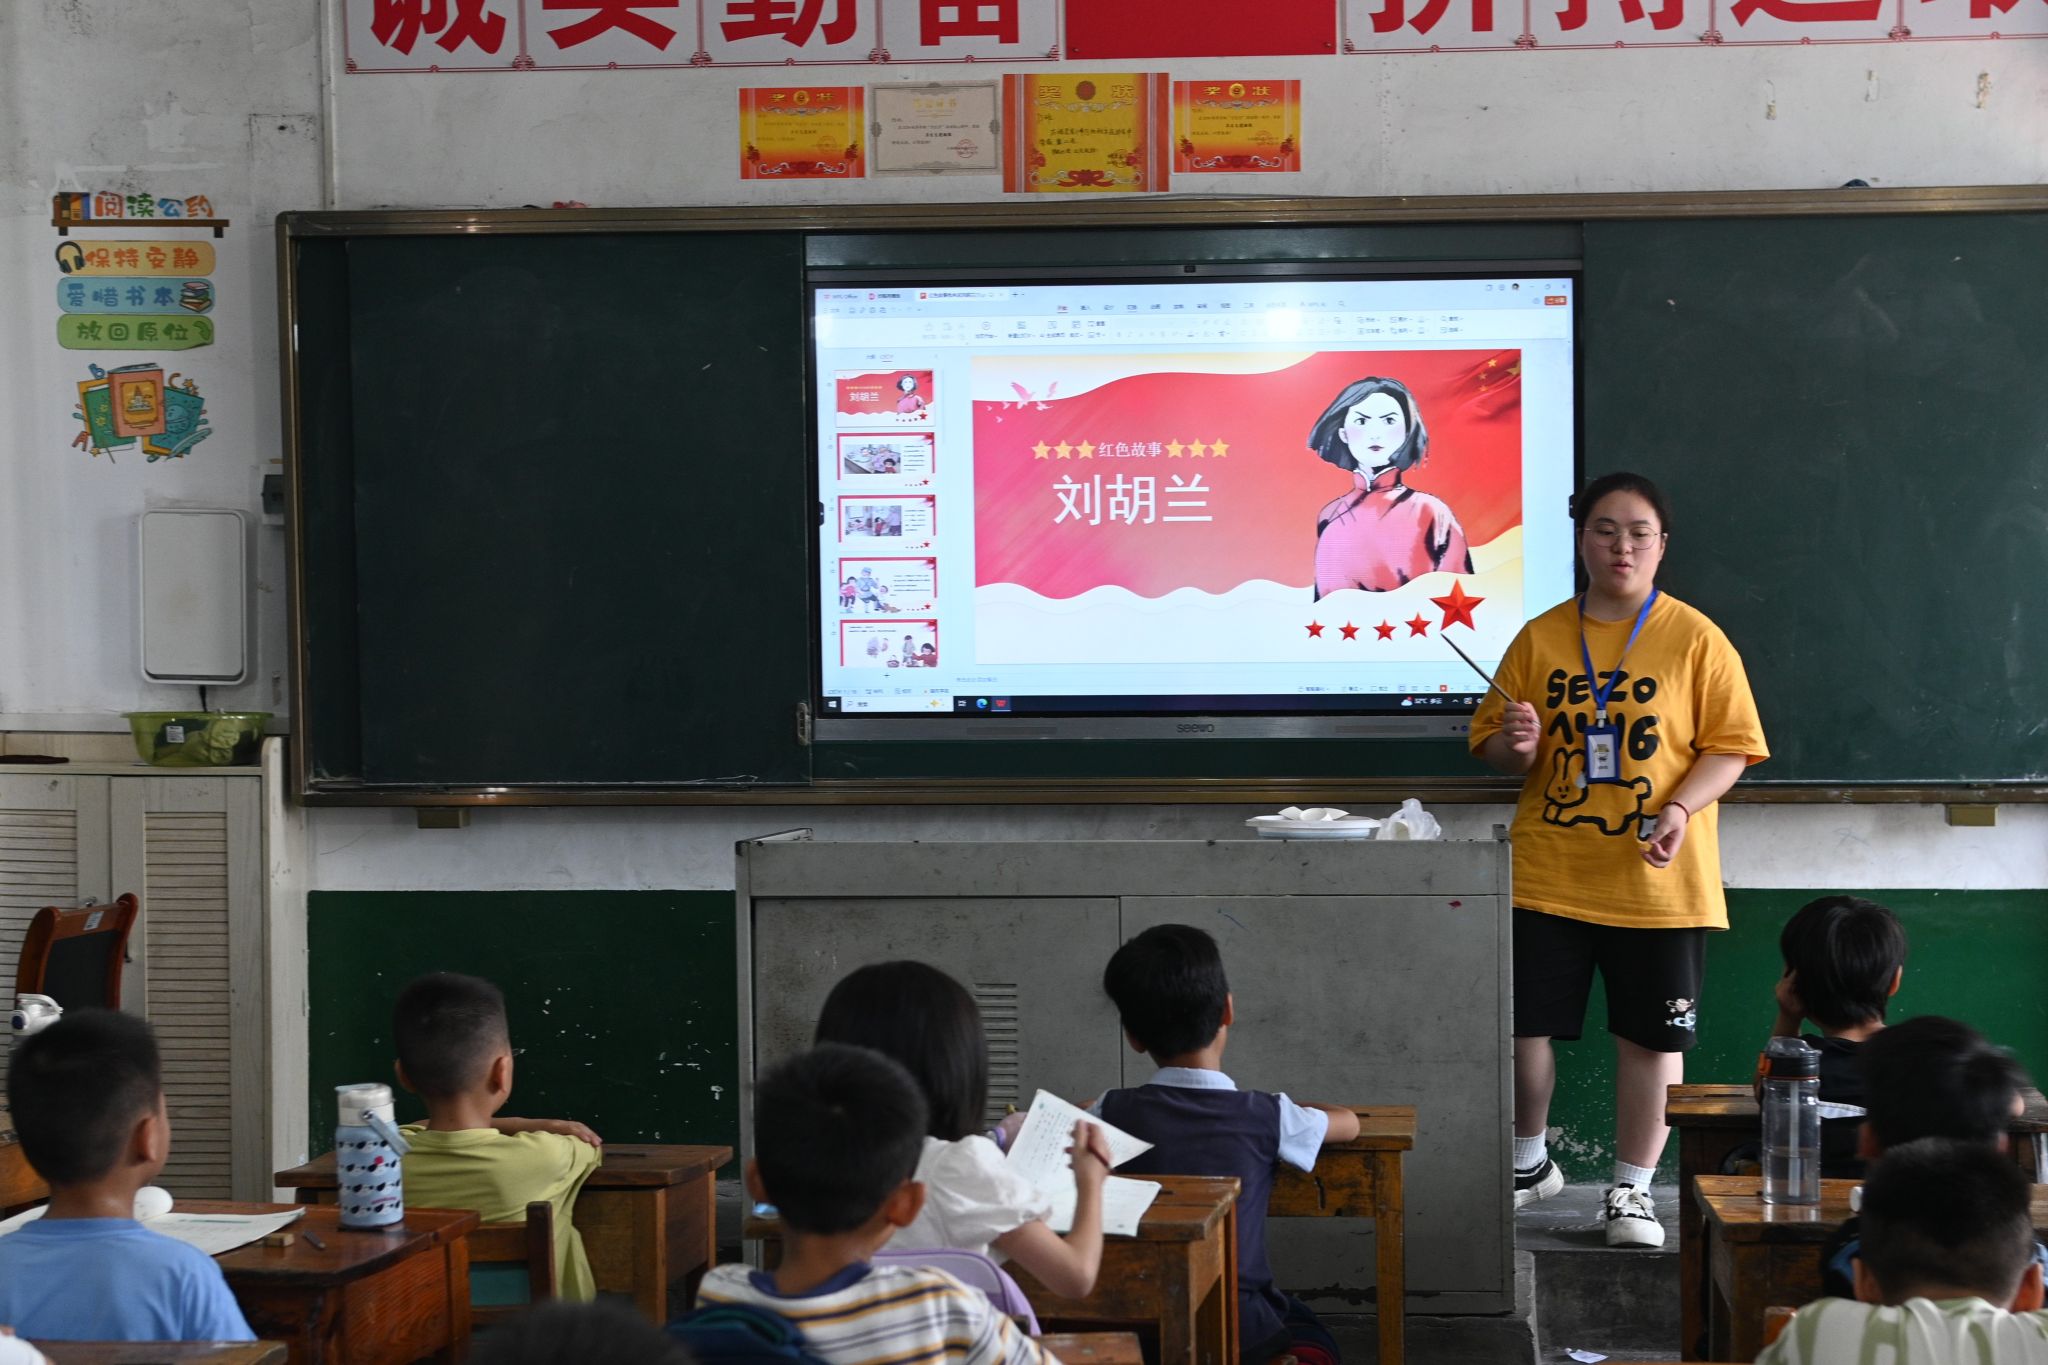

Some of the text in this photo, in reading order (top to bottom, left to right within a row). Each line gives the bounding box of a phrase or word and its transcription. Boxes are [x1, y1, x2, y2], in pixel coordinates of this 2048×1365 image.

[95, 190, 214, 218] 阅读公约
[85, 247, 199, 269] 保持安静
[67, 283, 174, 307] 爱惜书本
[77, 320, 188, 341] 放回原位
[1098, 441, 1162, 458] 红色故事
[1053, 473, 1213, 526] 刘胡兰
